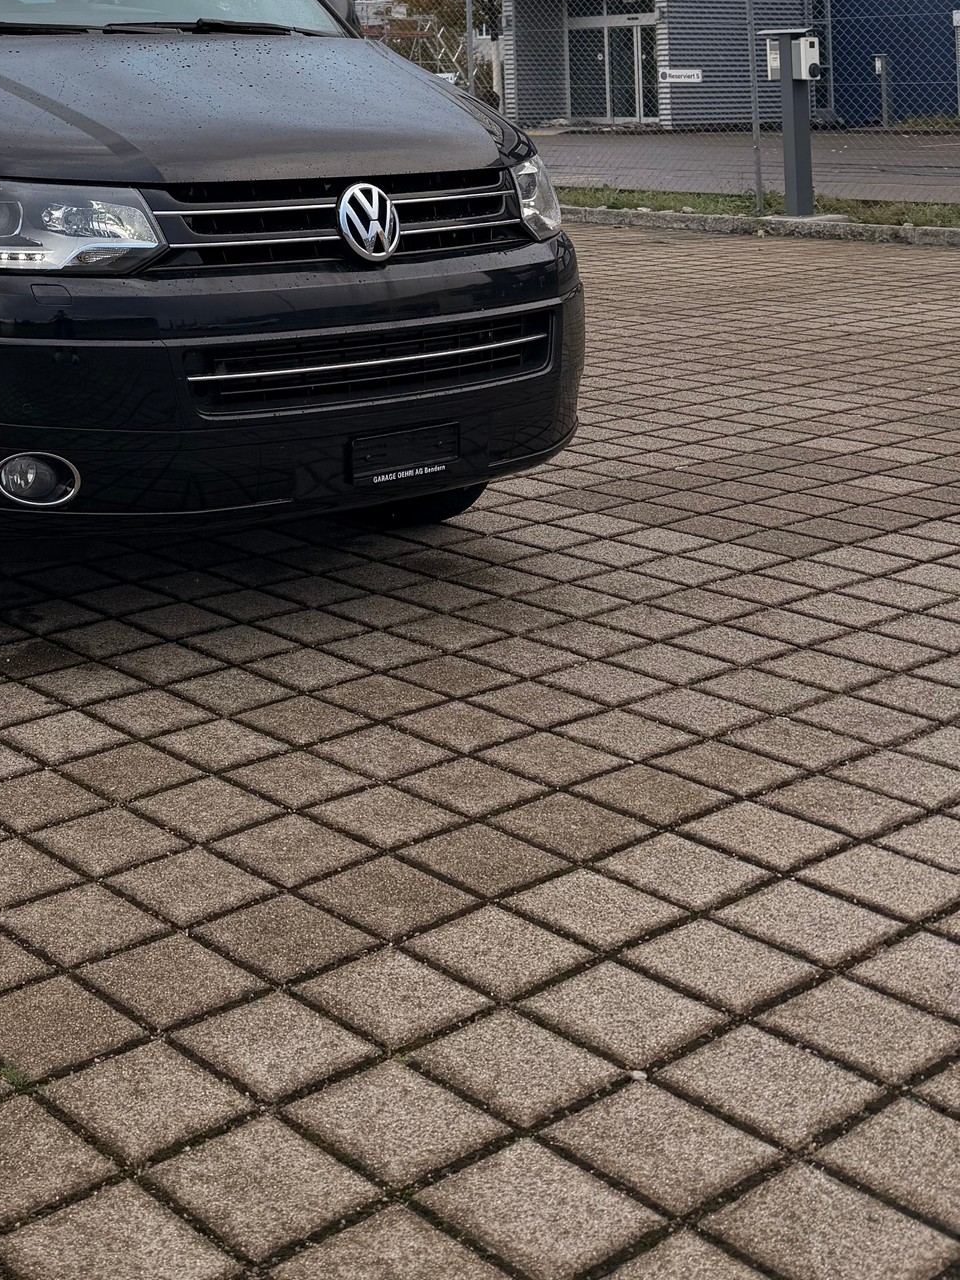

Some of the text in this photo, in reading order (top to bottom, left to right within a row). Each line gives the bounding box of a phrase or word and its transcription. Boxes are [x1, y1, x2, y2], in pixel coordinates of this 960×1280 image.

[339, 183, 400, 261] VW
[373, 465, 446, 483] GARAGE OEHRI AG Bendern
